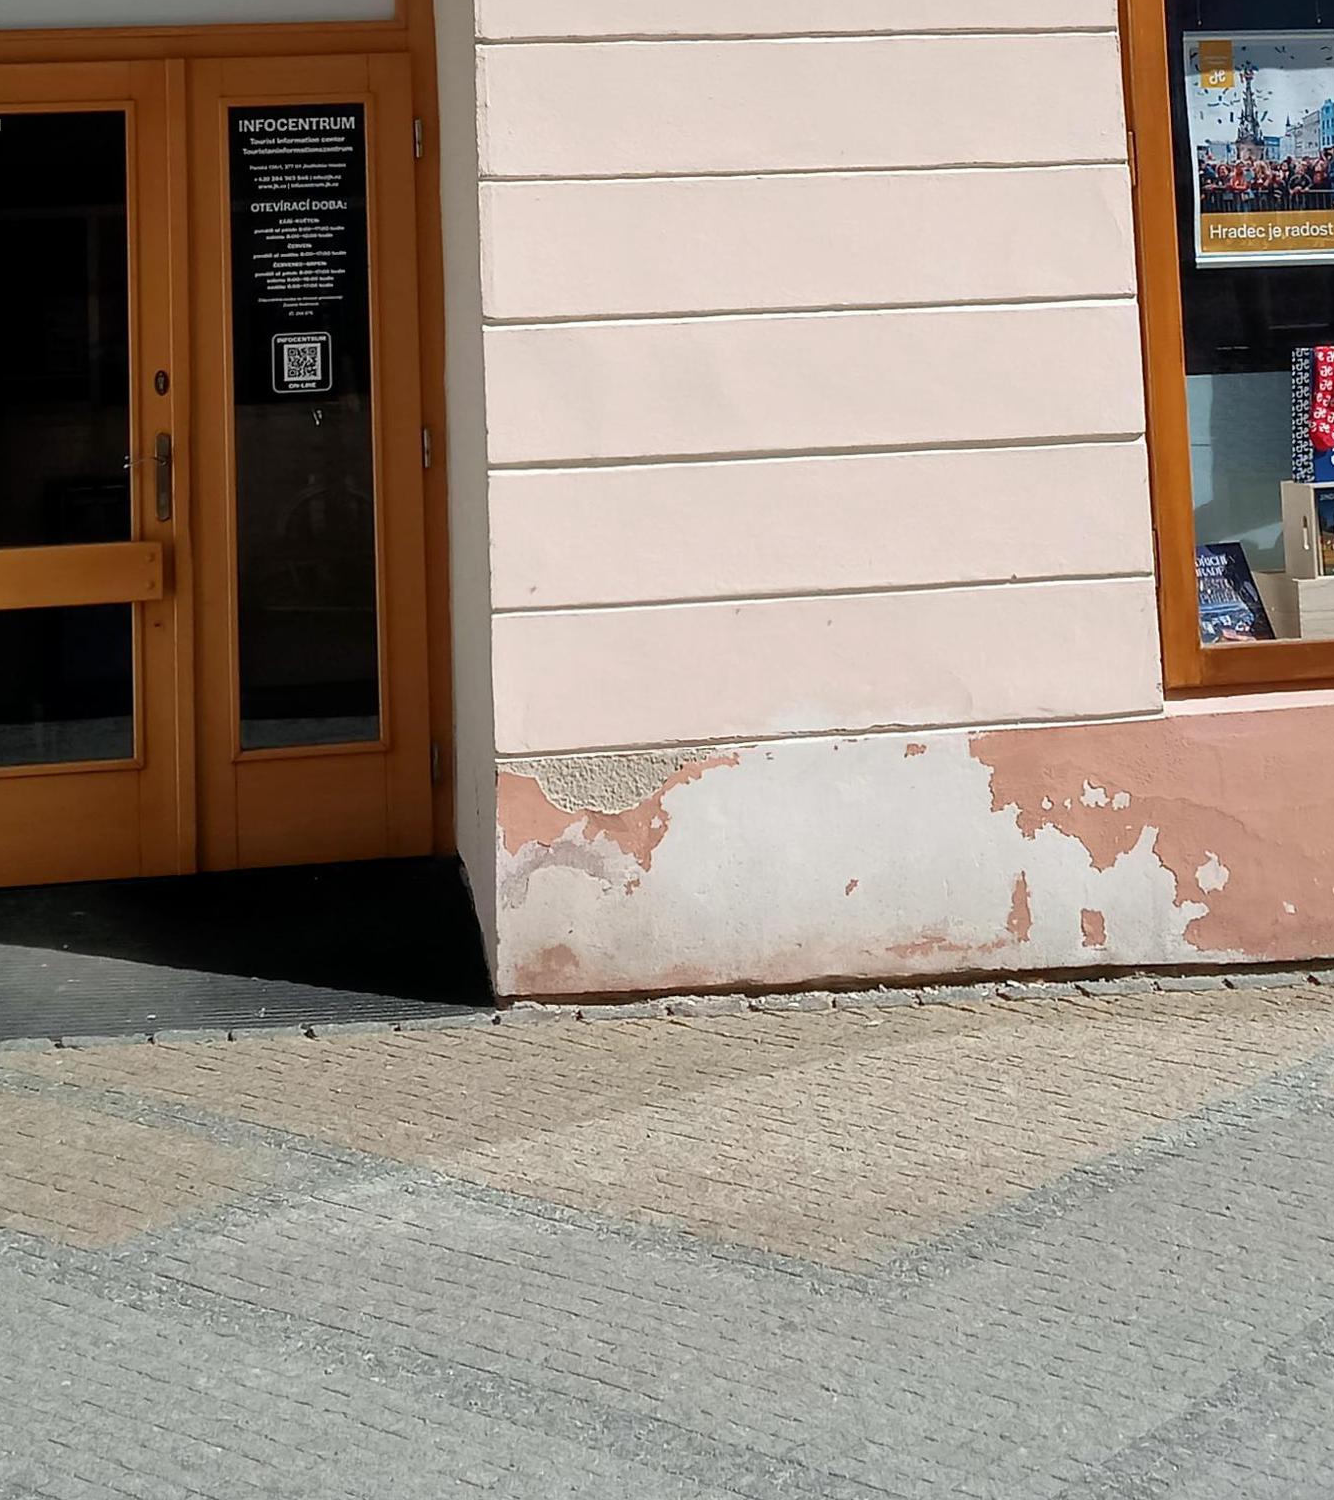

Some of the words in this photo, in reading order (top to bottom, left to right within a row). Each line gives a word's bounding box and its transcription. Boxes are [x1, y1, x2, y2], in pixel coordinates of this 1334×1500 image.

[238, 116, 356, 133] INFOCENTRUM
[250, 198, 310, 213] OTEVÍRACÍ
[312, 200, 348, 211] DOBA:
[1210, 223, 1266, 240] Hradec
[1267, 224, 1281, 242] je
[1284, 222, 1334, 238] radost
[276, 335, 327, 343] INFOCENTRUM
